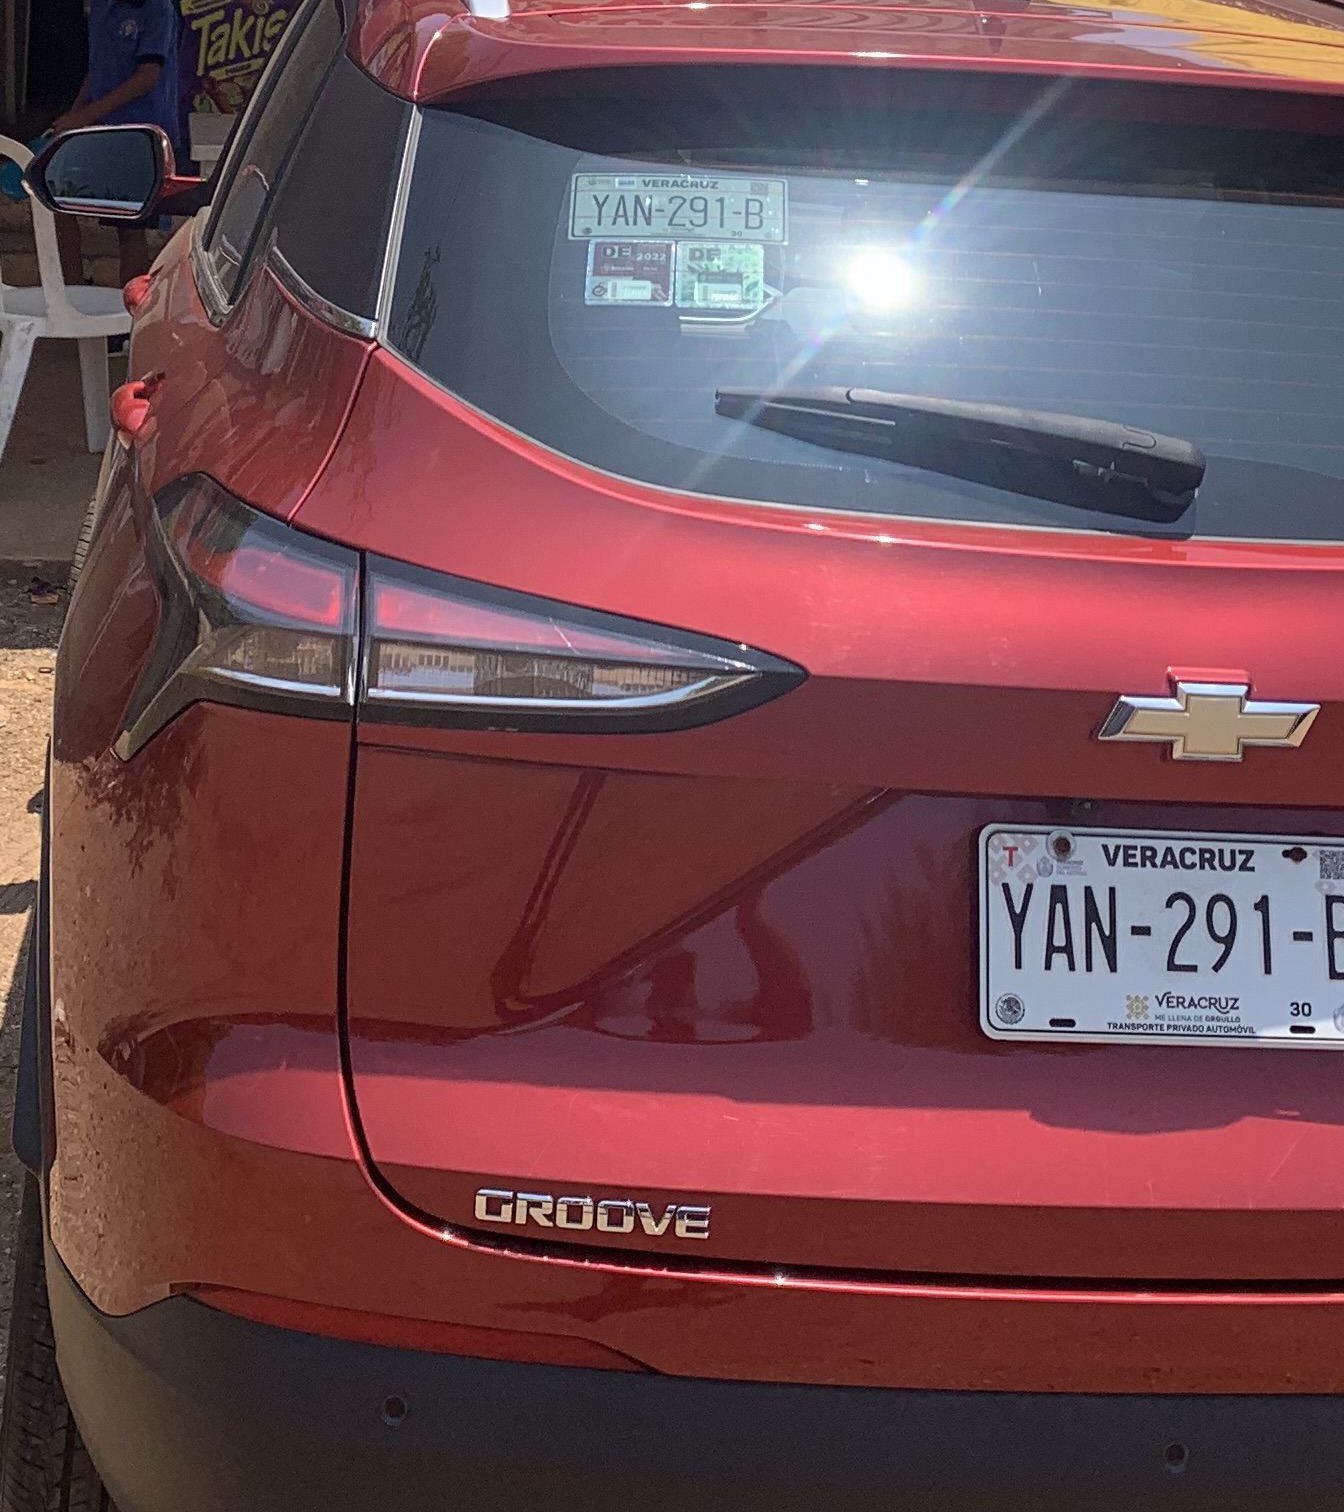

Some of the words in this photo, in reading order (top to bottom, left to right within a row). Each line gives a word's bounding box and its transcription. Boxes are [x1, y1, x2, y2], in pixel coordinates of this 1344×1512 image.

[191, 7, 288, 76] Takis
[642, 178, 719, 190] VERACRUZ
[593, 193, 765, 230] YAN-291-B
[1002, 846, 1019, 868] T
[1102, 843, 1256, 873] VERACRUZ
[1155, 991, 1240, 1015] VERACRUZ
[1290, 1001, 1312, 1018] 30
[1107, 1022, 1165, 1032] TRANSPORTE
[1166, 1023, 1205, 1033] PRIVADO
[474, 1187, 712, 1240] GROOVE
